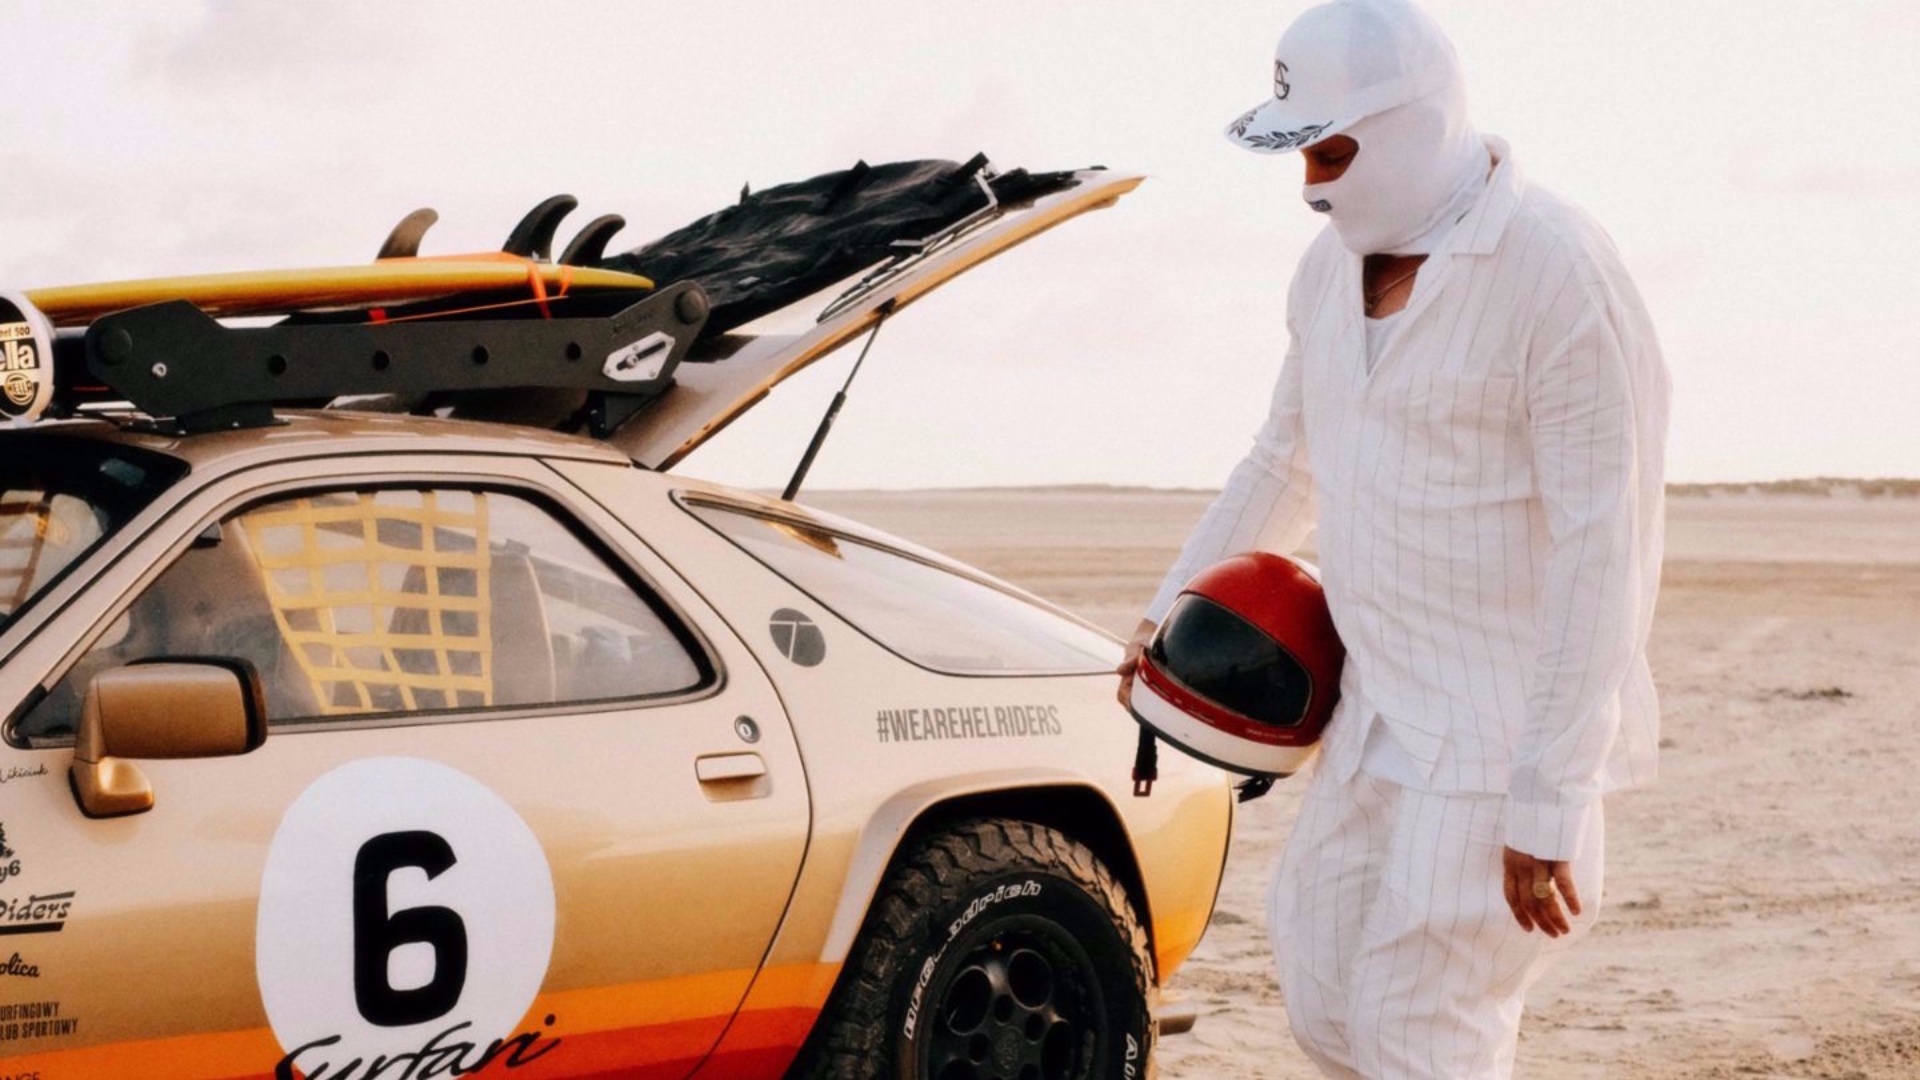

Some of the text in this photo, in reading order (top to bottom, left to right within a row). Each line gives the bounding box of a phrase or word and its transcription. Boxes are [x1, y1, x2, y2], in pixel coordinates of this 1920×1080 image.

[876, 704, 1062, 742] #WEAREHELRIDERS
[353, 830, 468, 1027] 6
[22, 1018, 78, 1038] SPORTOWY
